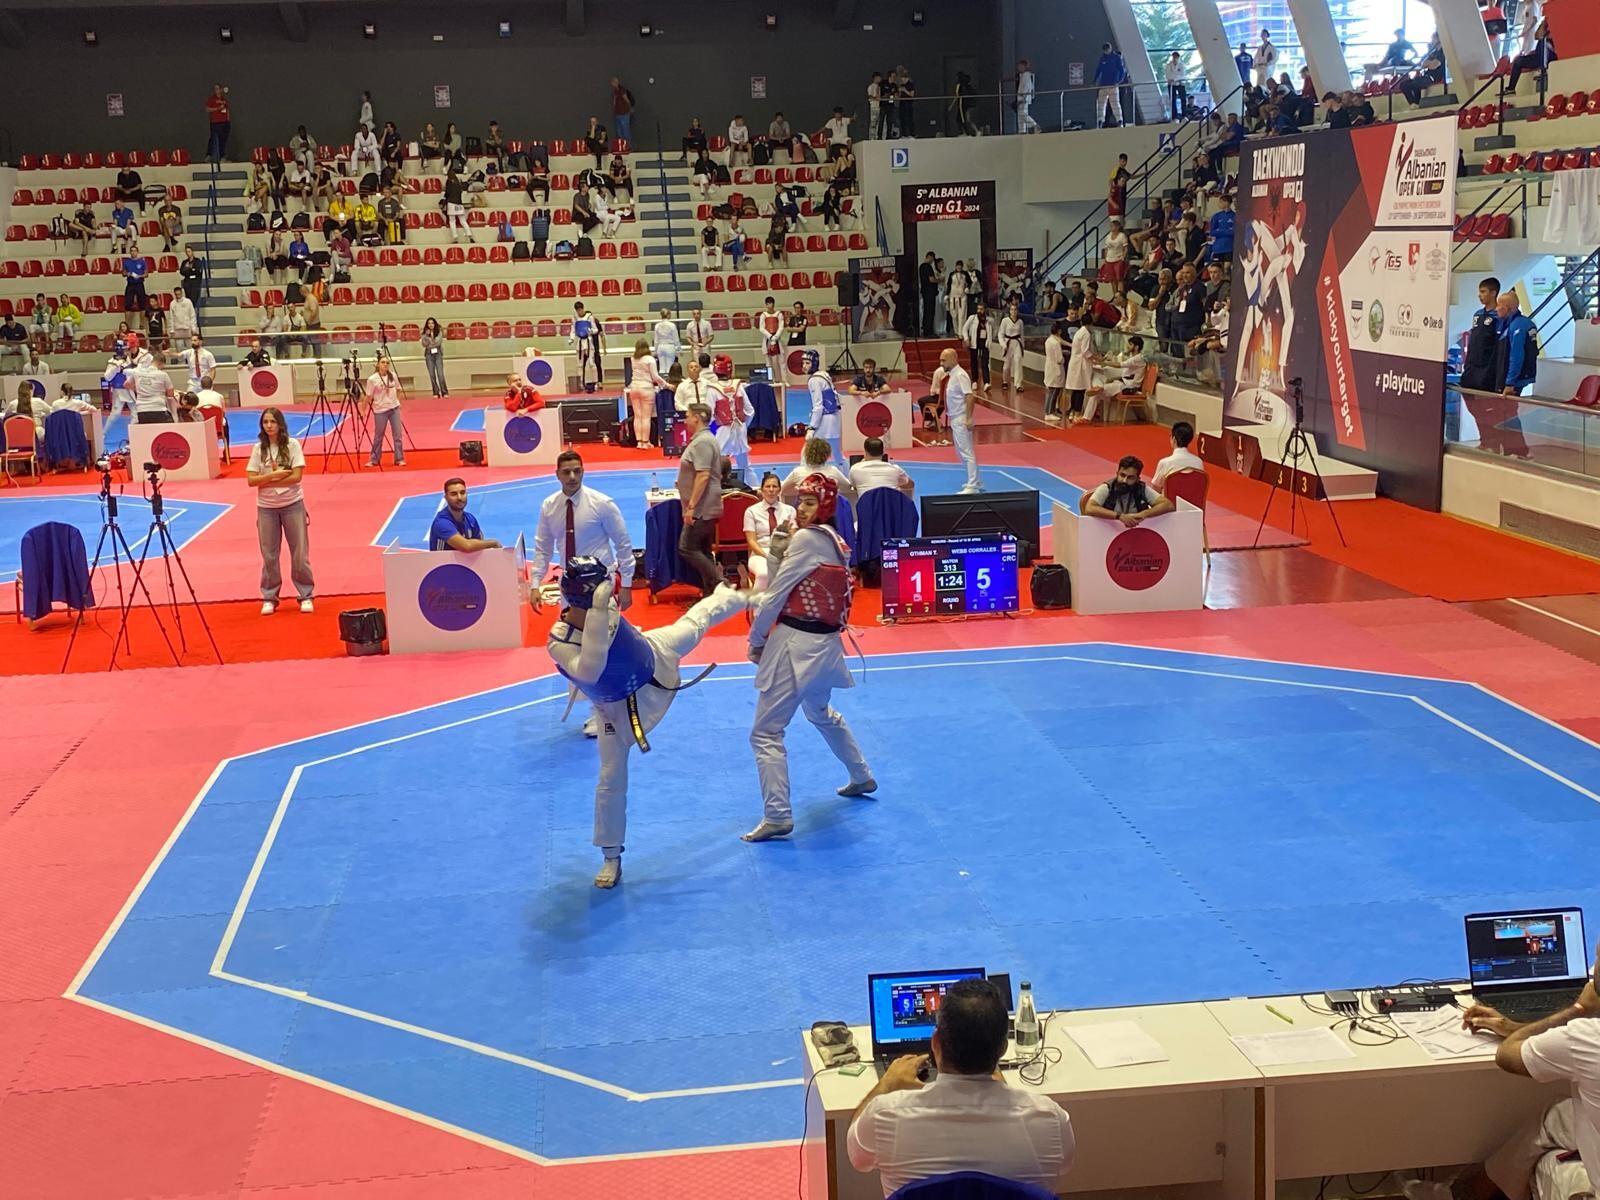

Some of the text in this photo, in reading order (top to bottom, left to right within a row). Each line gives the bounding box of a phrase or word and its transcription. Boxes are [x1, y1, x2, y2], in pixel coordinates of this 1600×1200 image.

[893, 149, 907, 167] D
[1252, 143, 1305, 181] TAEKWONDO
[1404, 157, 1446, 179] Albanian
[928, 186, 978, 199] ALBANIAN
[1399, 181, 1415, 196] OPEN
[915, 203, 943, 214] OPEN
[945, 200, 962, 213] G1
[1200, 437, 1205, 454] 2
[1301, 476, 1308, 493] 3
[883, 561, 898, 569] GBR
[910, 571, 922, 593] 1
[937, 574, 963, 587] 1:24
[976, 567, 991, 590] 5
[903, 998, 910, 1009] 5
